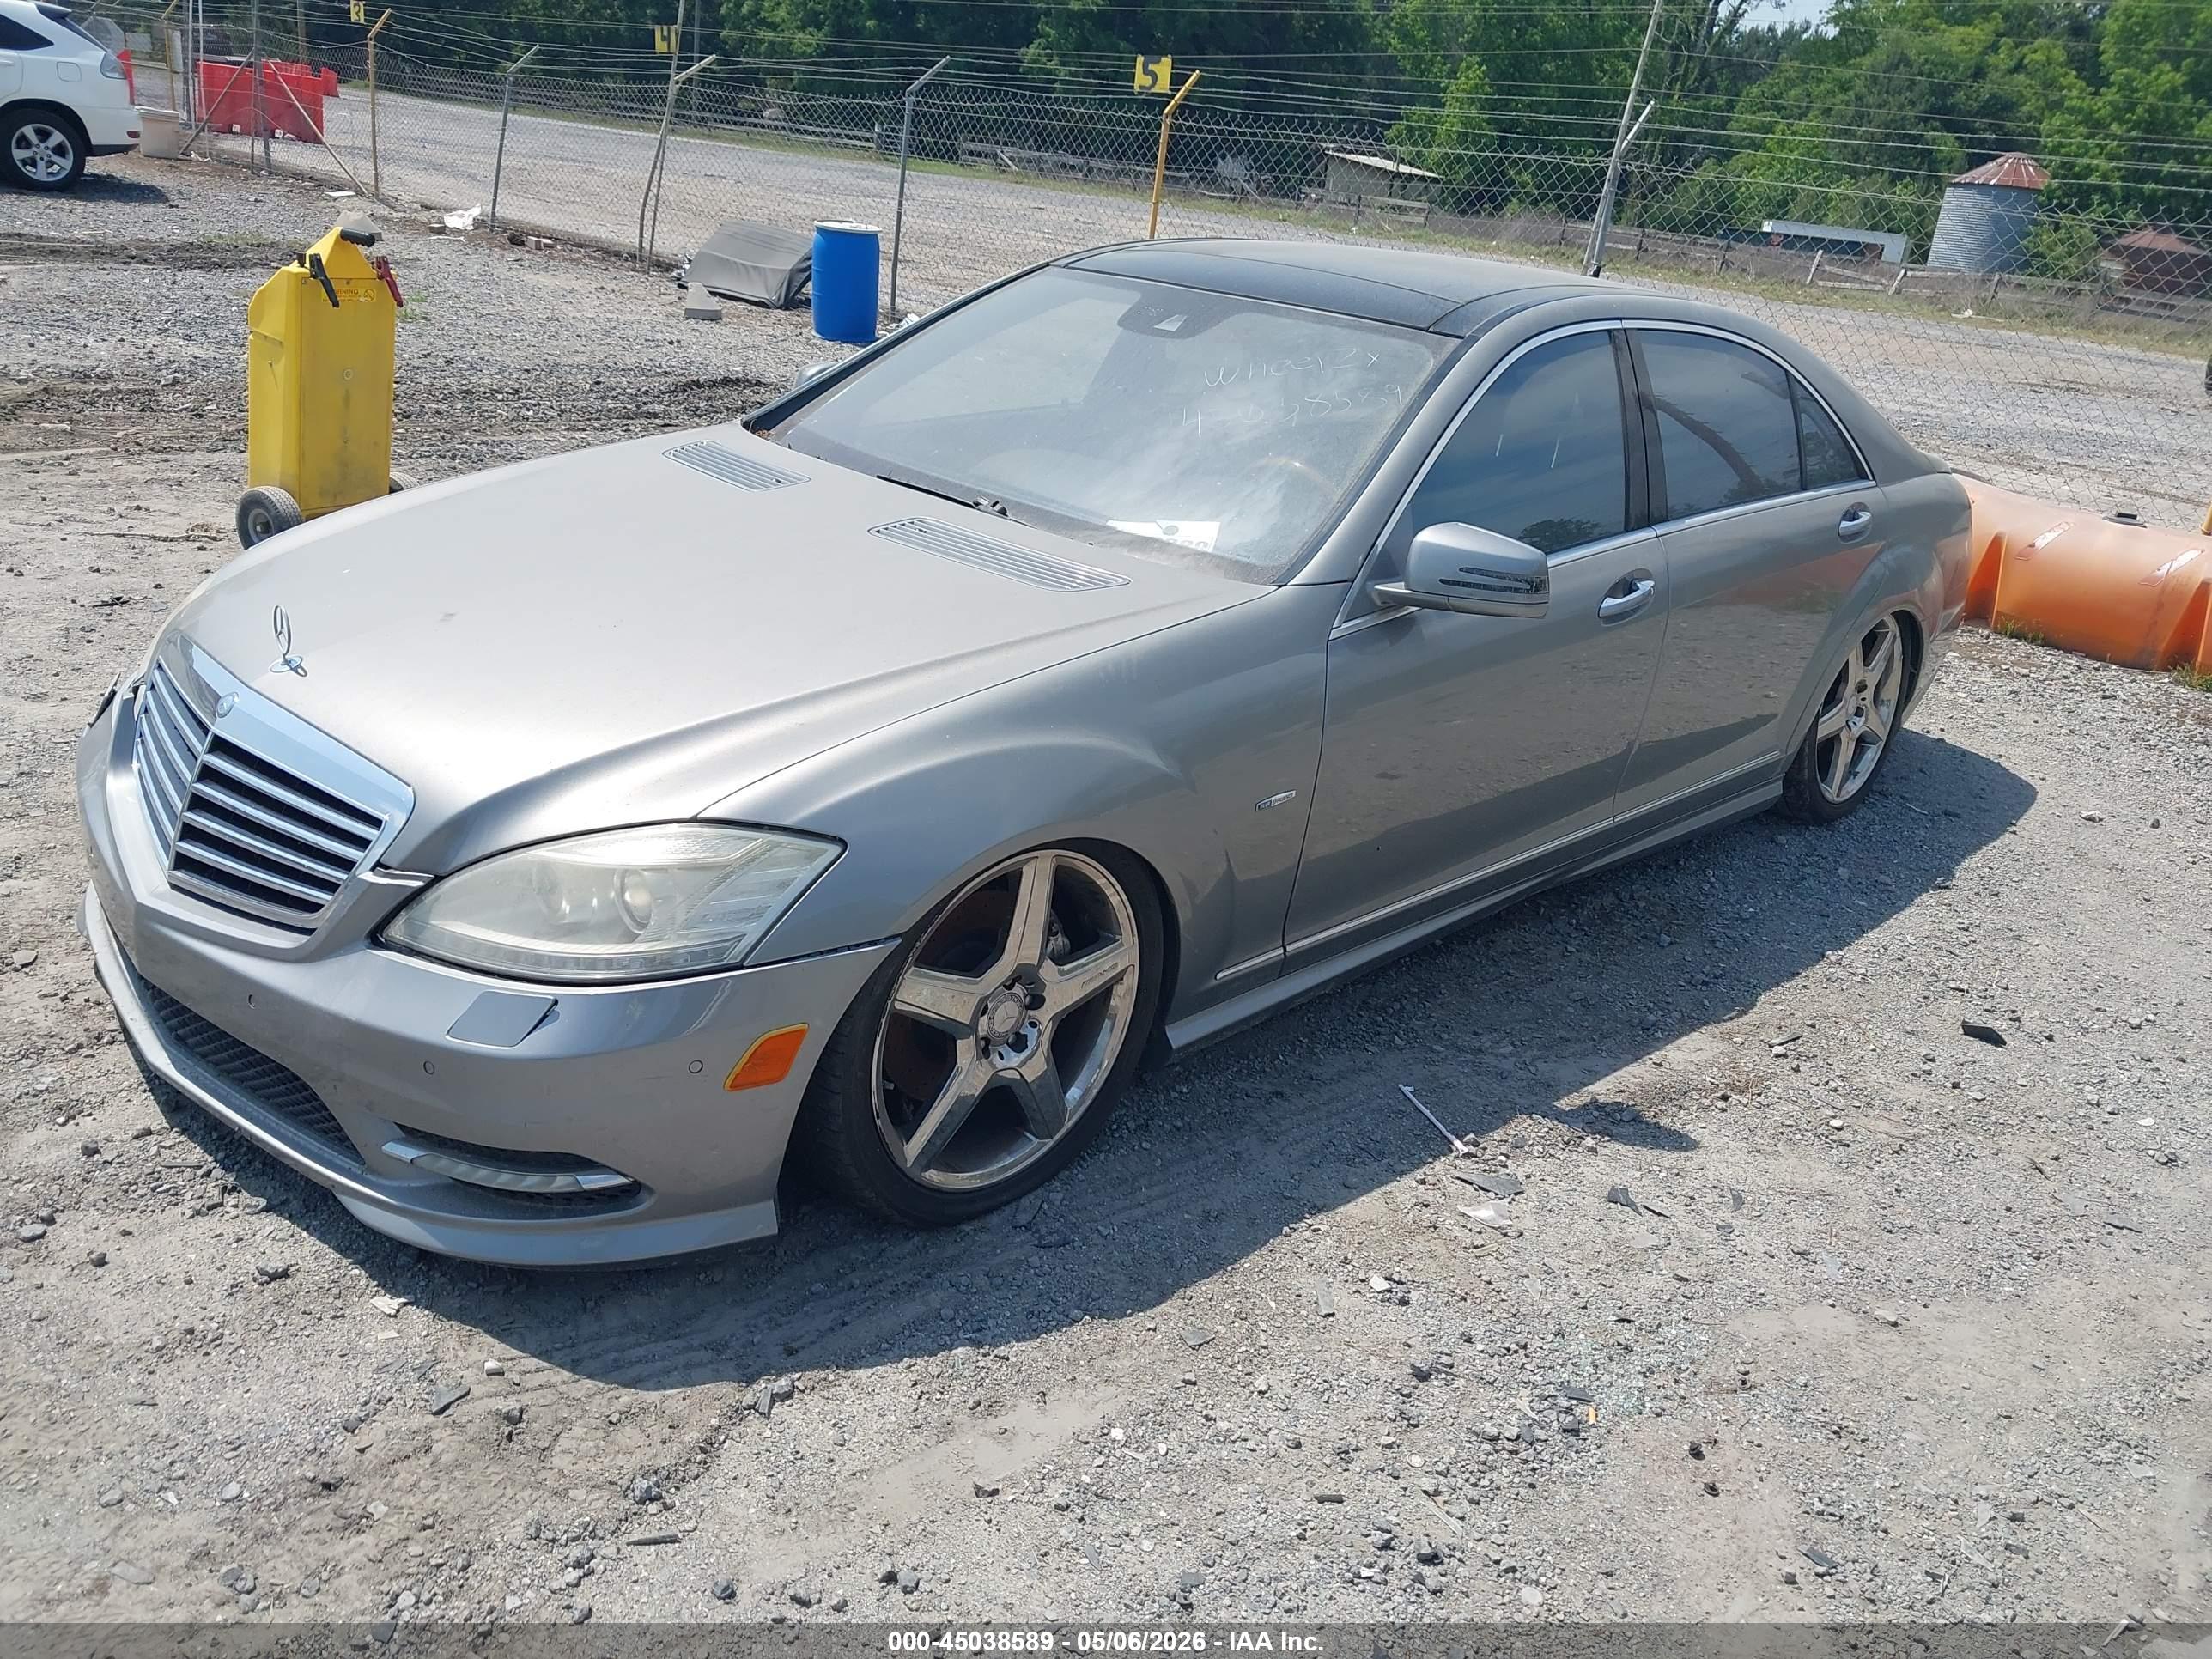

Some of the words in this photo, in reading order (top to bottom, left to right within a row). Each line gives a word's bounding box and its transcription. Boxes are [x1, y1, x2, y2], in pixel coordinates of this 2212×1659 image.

[353, 3, 361, 21] 3
[660, 26, 672, 52] 4
[1139, 55, 1163, 91] 5
